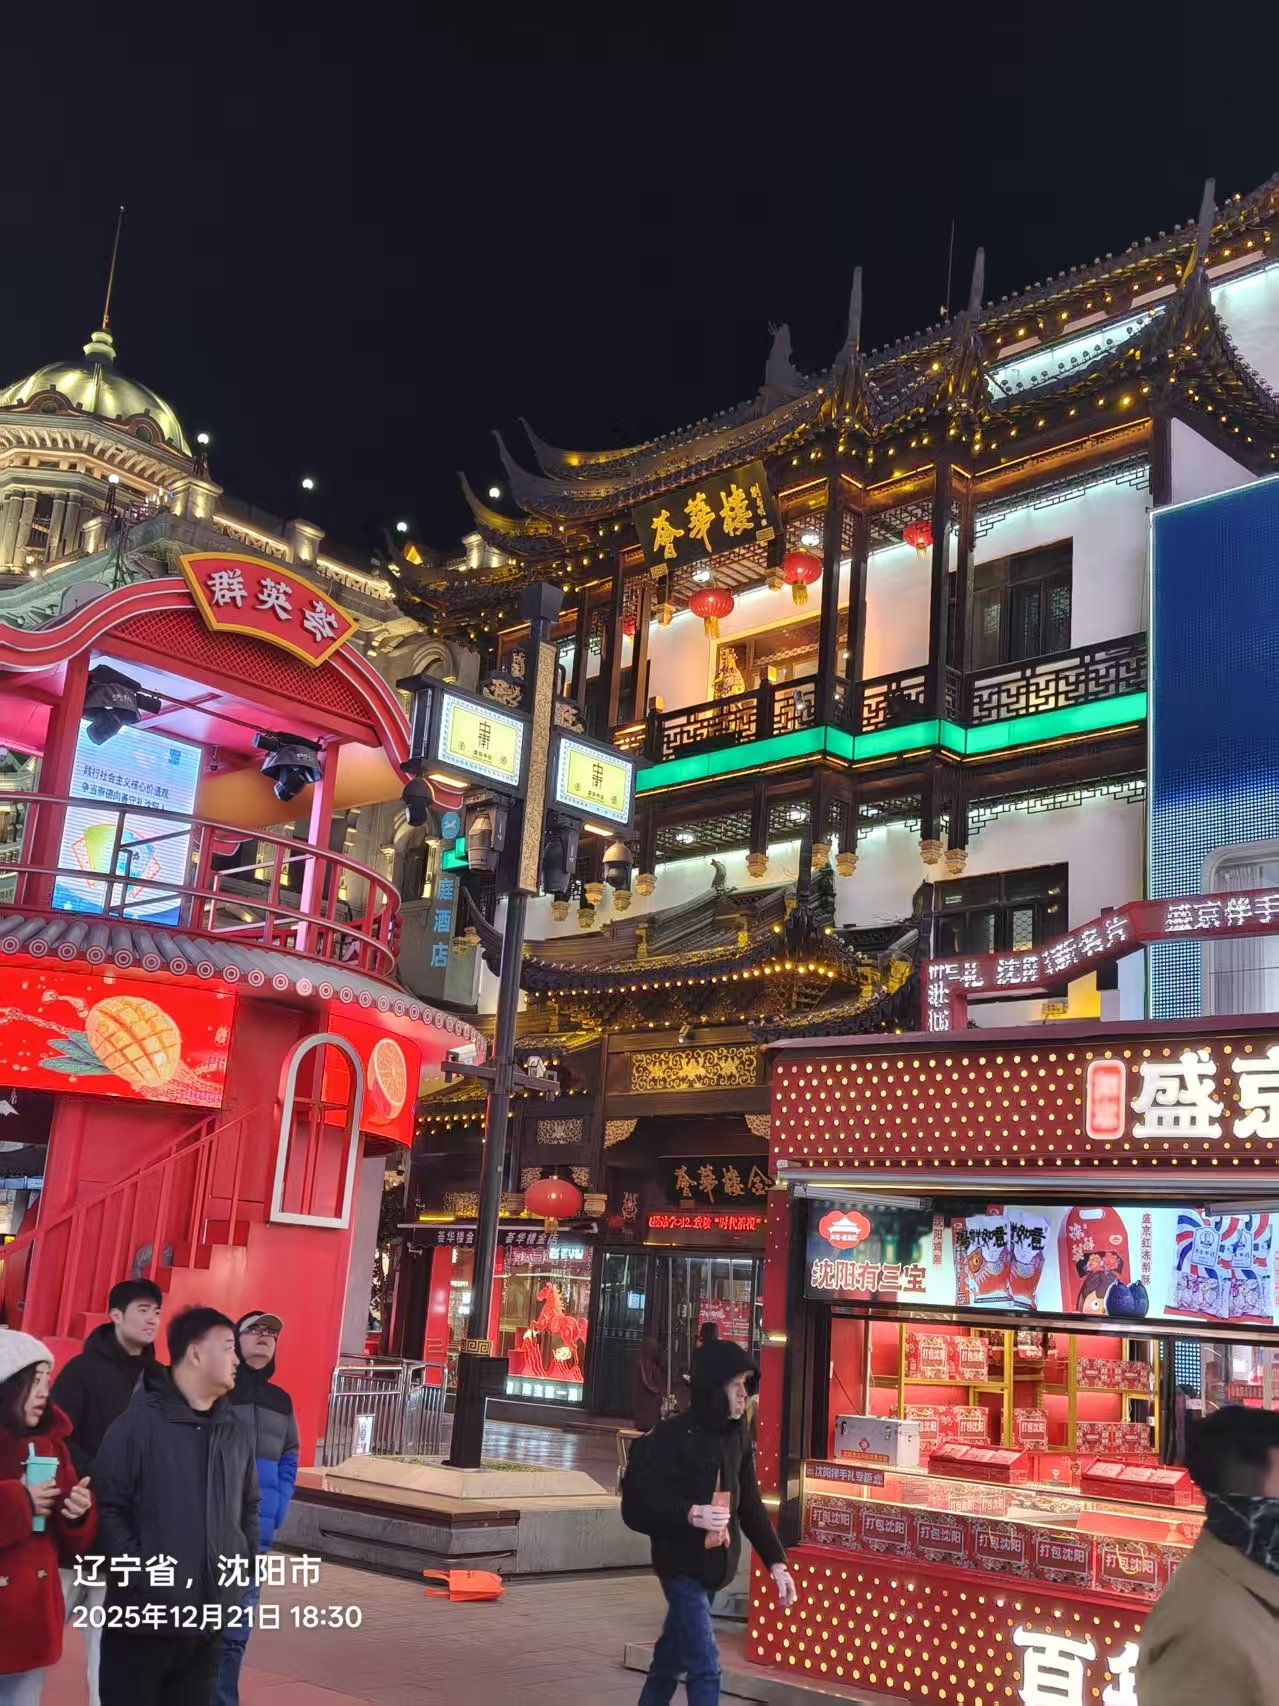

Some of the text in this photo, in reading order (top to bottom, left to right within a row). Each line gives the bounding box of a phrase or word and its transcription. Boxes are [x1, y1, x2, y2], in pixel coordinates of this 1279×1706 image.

[207, 568, 339, 643] 群英荟
[83, 764, 169, 800] 践行社会主义核心价值观
[811, 1258, 927, 1293] 沈阳有三宝
[812, 1508, 850, 1526] 打包沈阳
[865, 1517, 905, 1535] 打包沈阳
[920, 1526, 961, 1543] 打包沈阳
[979, 1533, 1022, 1553] 打包沈阳
[1040, 1544, 1085, 1563] 打包沈阳
[1106, 1554, 1154, 1574] 打包沈阳
